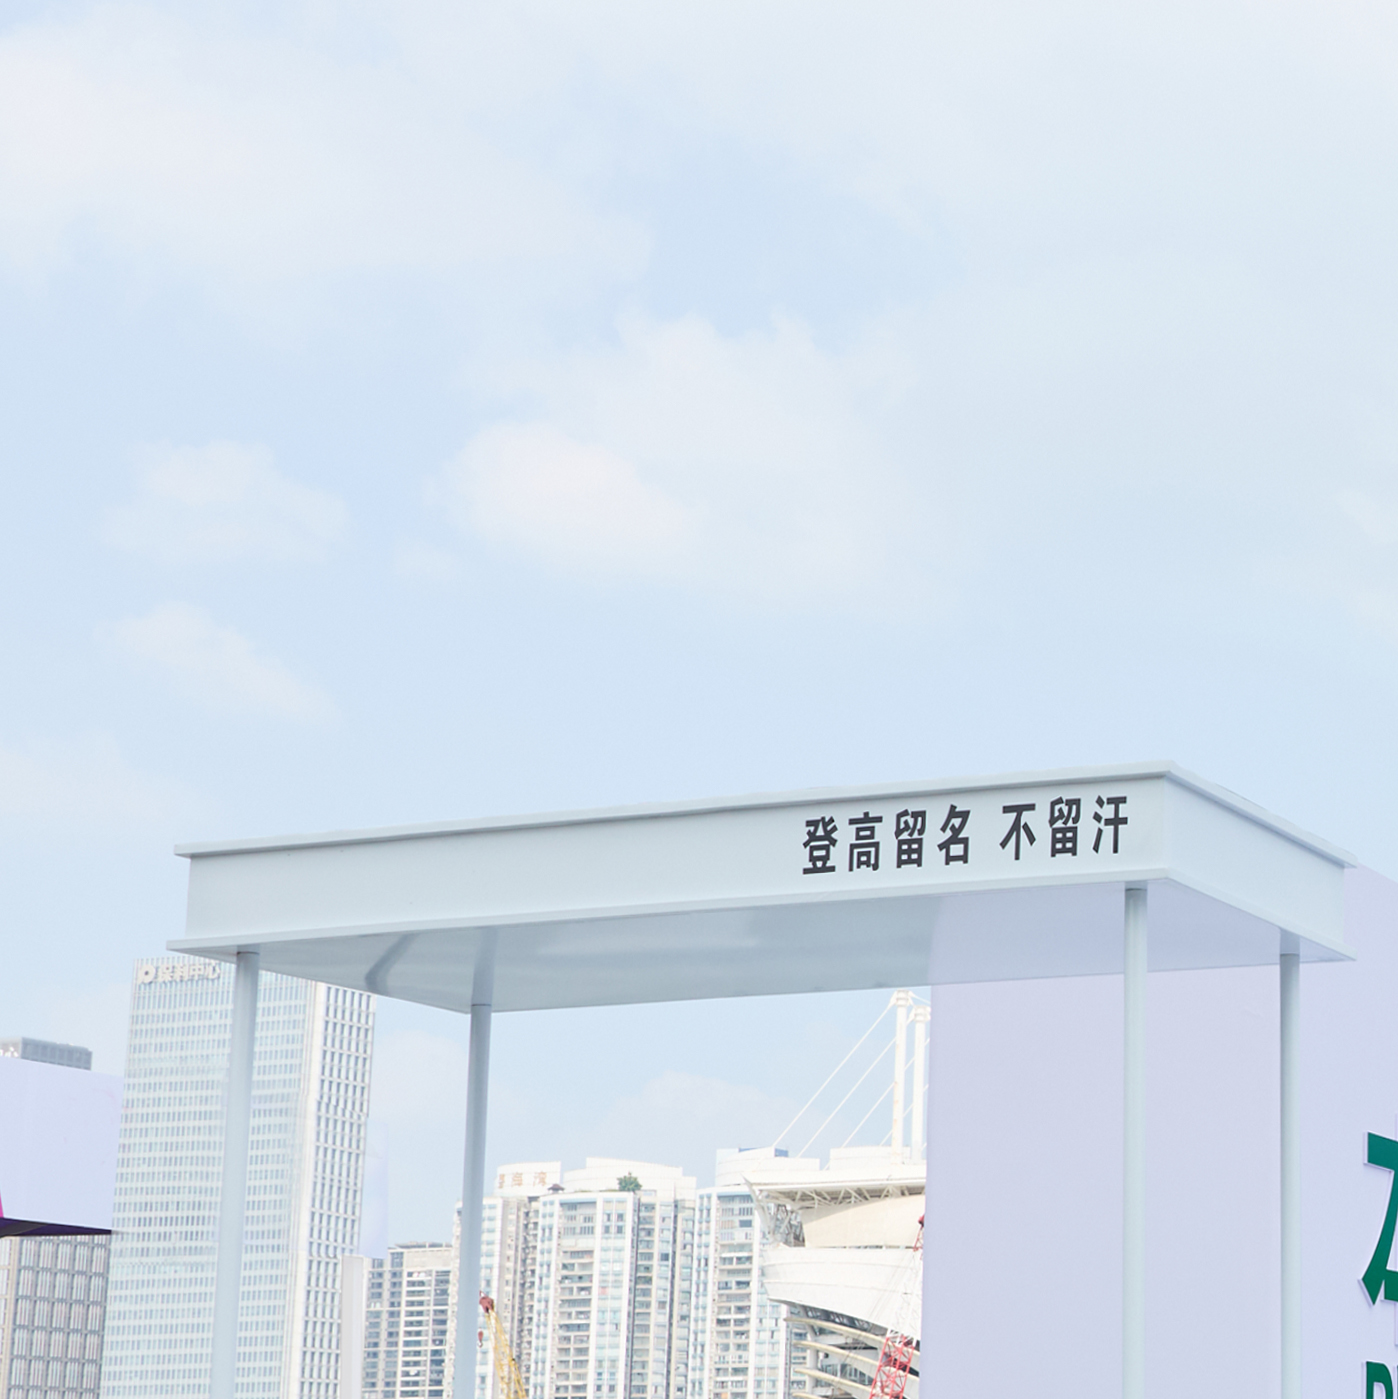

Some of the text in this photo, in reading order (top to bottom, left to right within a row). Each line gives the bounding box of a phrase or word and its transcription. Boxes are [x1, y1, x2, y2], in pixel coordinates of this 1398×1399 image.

[802, 794, 1128, 876] 登高留名 不留汗
